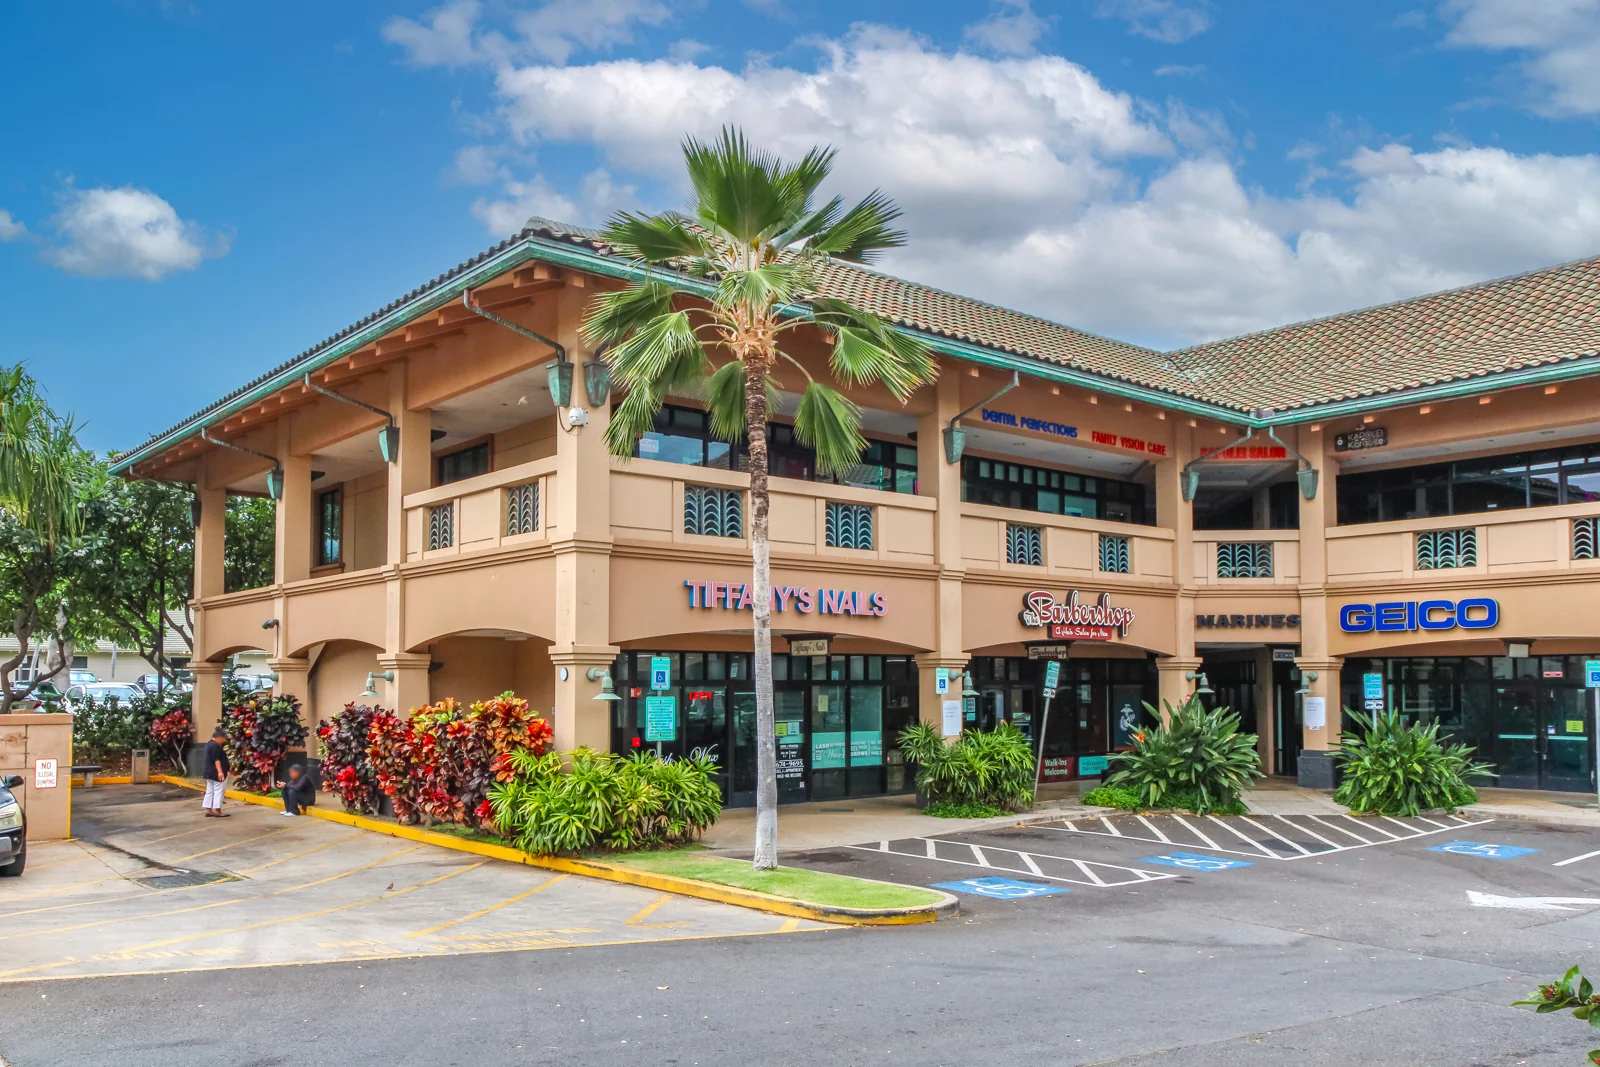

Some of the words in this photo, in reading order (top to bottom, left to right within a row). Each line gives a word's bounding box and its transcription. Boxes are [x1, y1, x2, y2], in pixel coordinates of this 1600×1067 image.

[982, 409, 1018, 427] DENTAL
[1020, 416, 1078, 438] PERFECTIONS
[1348, 429, 1383, 441] KAPOLEI
[1092, 431, 1117, 446] FAMILY
[1121, 436, 1145, 451] VISION
[1147, 442, 1167, 456] CARE
[1347, 438, 1384, 449] Karaoke
[819, 588, 888, 617] NAILS
[1026, 589, 1136, 637] Barbershop
[1339, 597, 1499, 633] GEICO
[1196, 614, 1301, 629] MARINES
[1074, 627, 1090, 636] Salon
[1274, 651, 1293, 659] GEICO
[1044, 759, 1067, 767] Walk-Ins
[1044, 768, 1068, 776] Welcome
